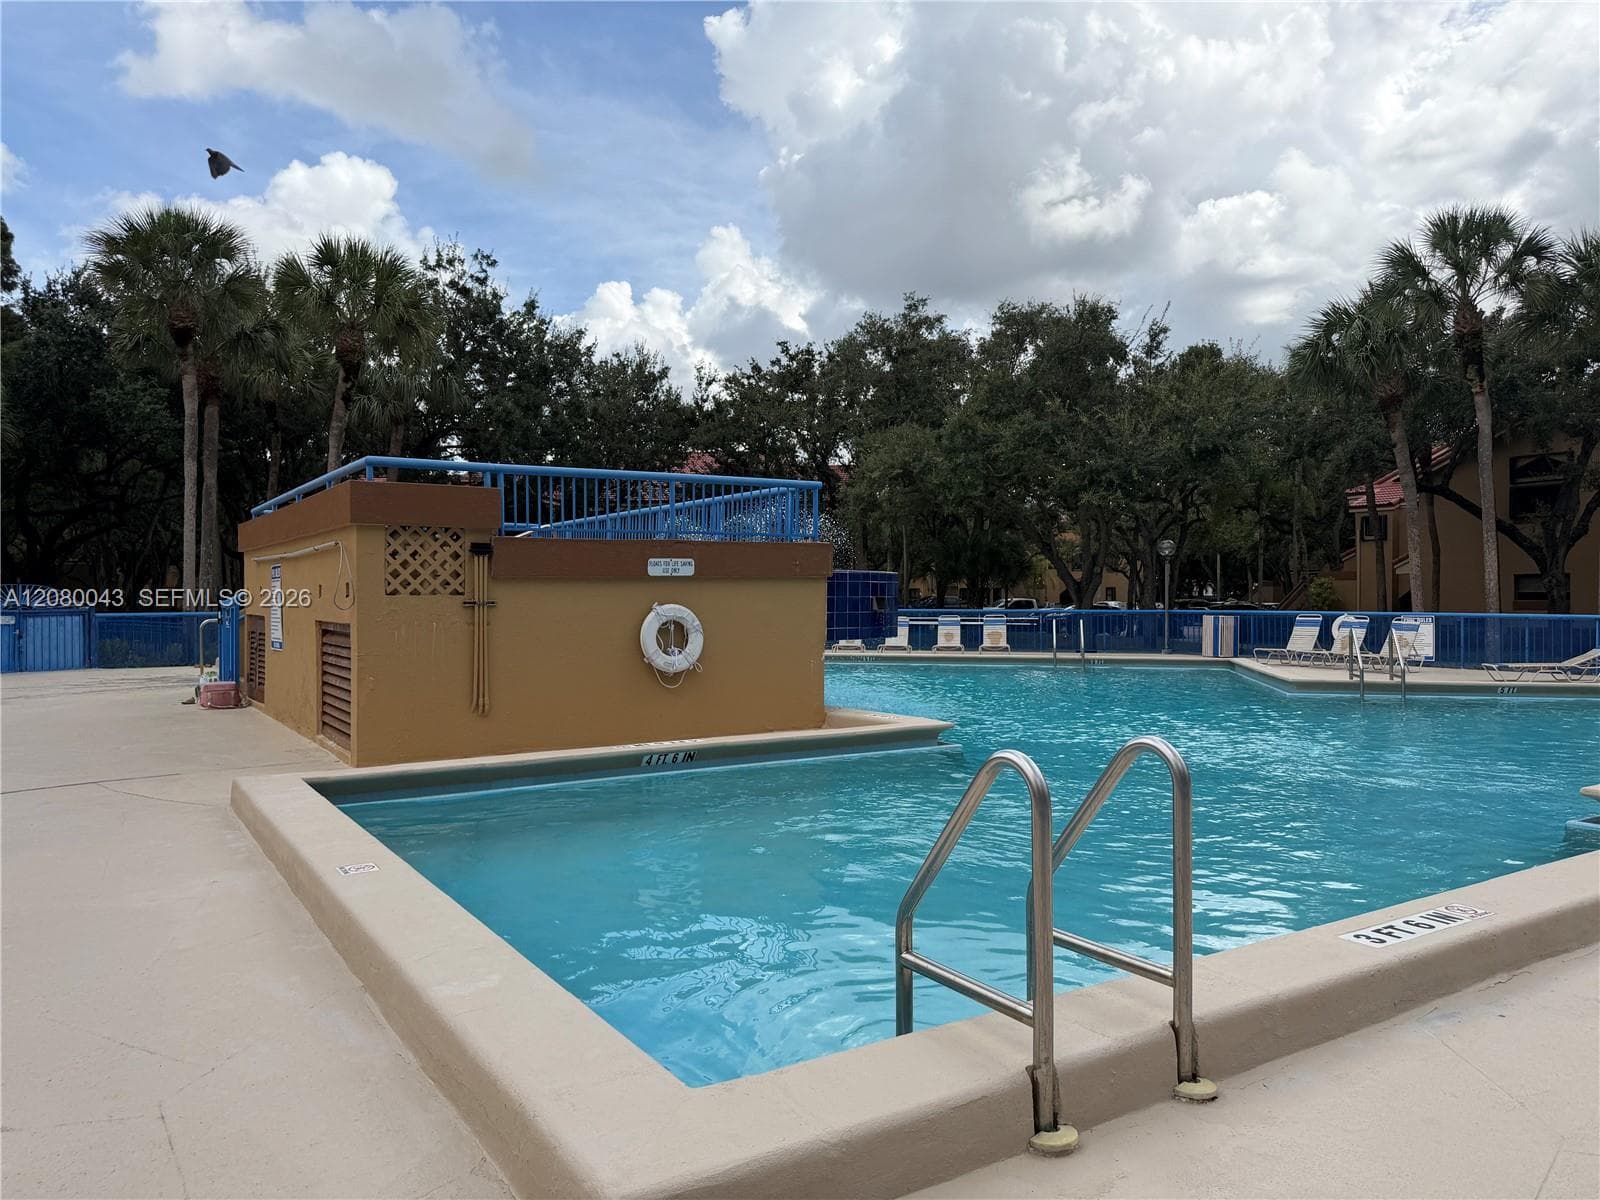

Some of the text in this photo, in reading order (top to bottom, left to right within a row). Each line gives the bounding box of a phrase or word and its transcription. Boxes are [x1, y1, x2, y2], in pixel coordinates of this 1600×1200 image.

[645, 754, 653, 766] 4
[672, 753, 679, 764] 6
[682, 752, 696, 763] IN
[1353, 934, 1387, 944] 3
[1371, 925, 1416, 939] FT
[1402, 920, 1436, 930] 6
[1419, 911, 1464, 925] IN
